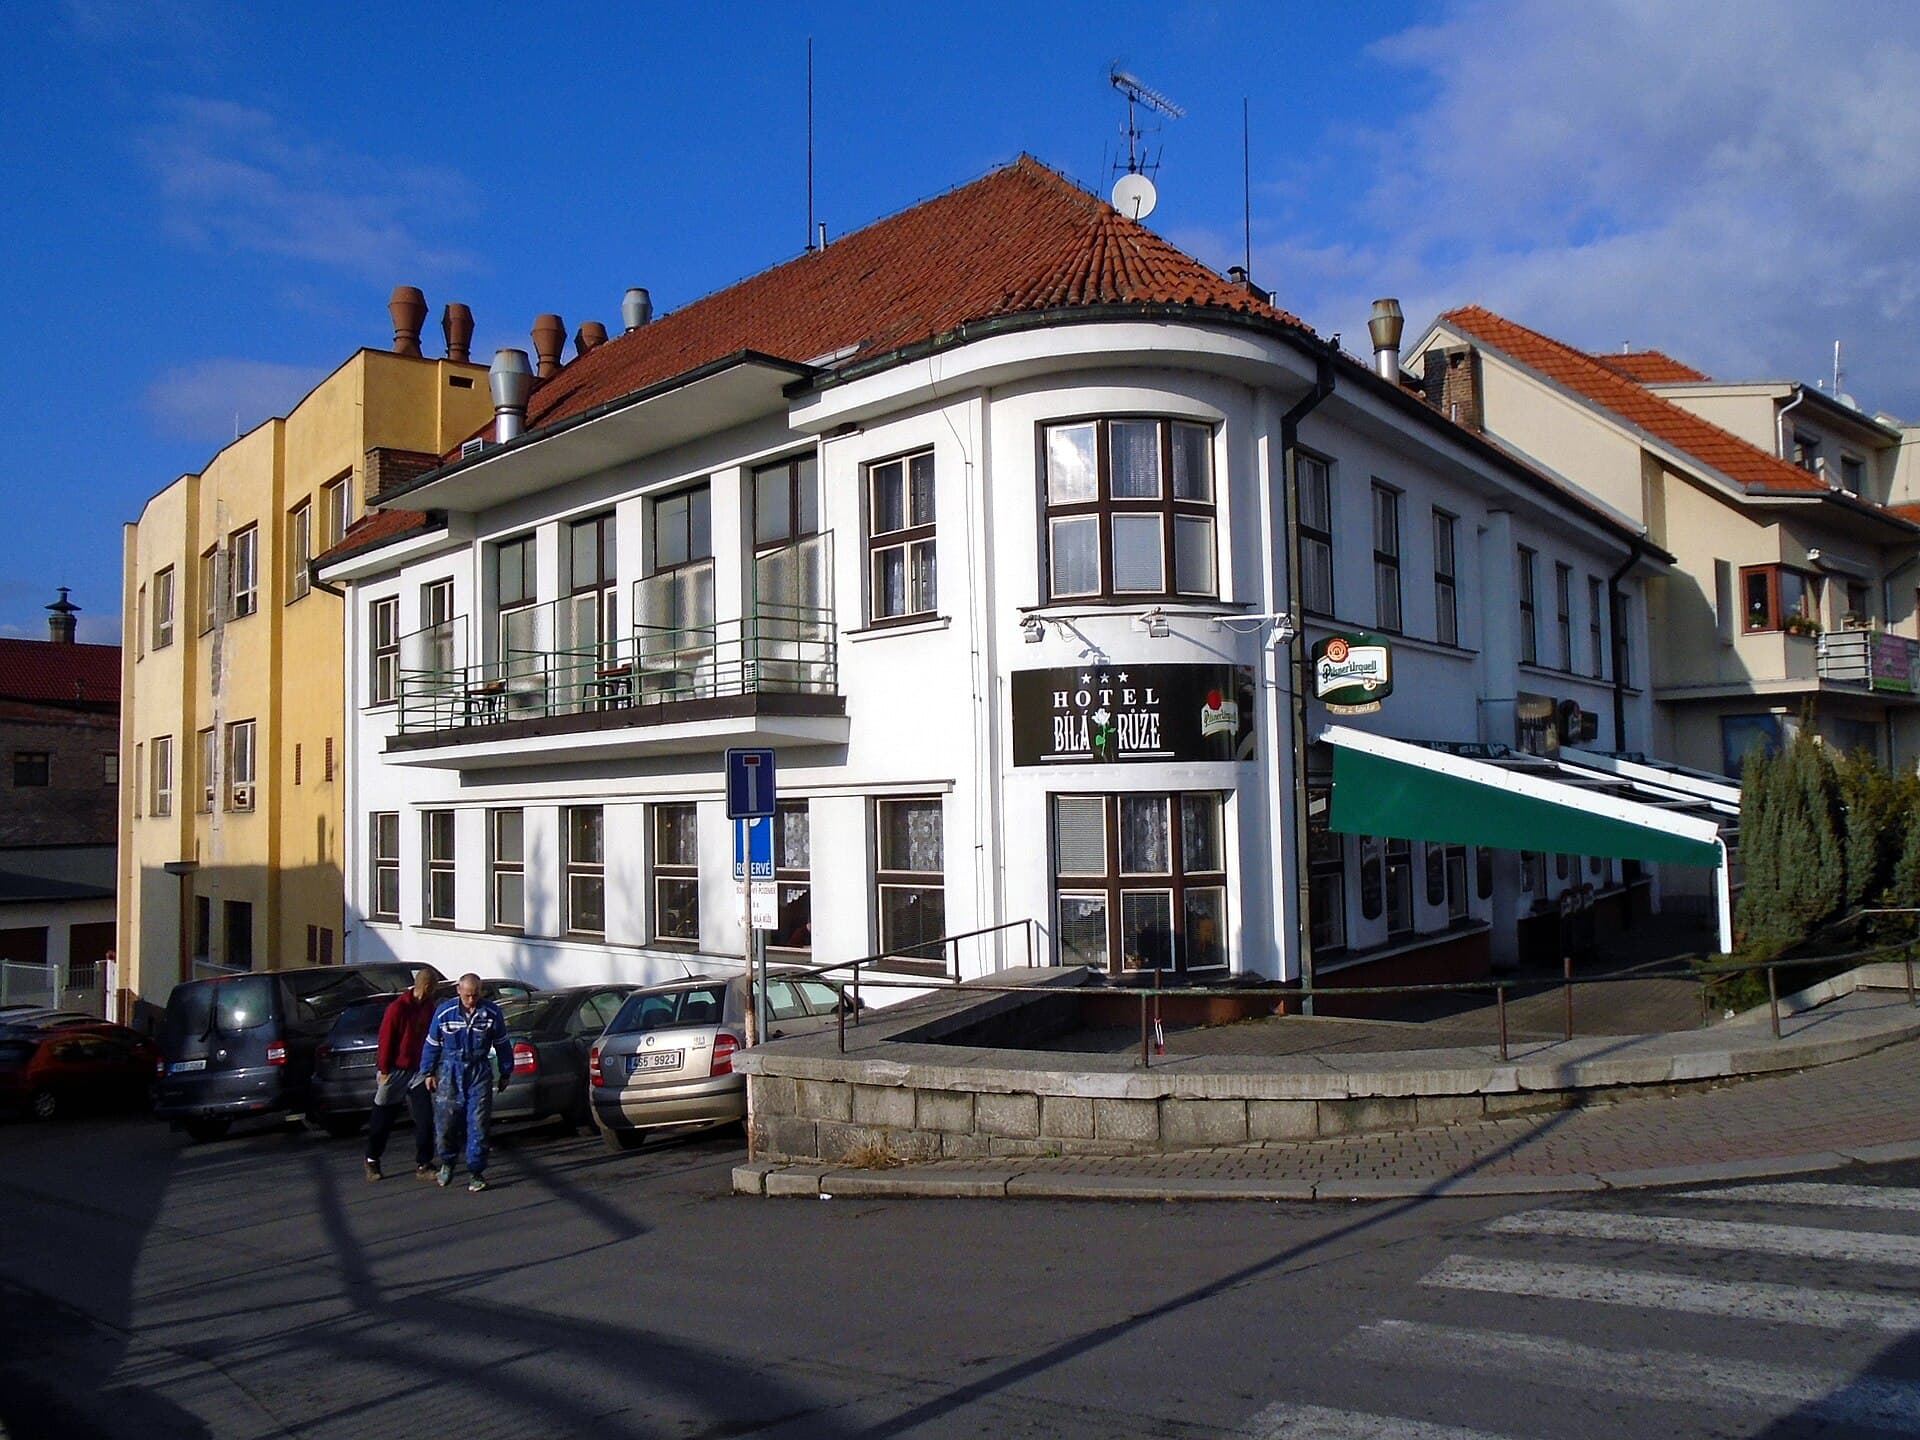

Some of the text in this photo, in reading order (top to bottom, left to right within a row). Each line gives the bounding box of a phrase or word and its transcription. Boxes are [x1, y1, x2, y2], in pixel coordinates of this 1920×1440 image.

[1322, 660, 1377, 684] Pilsner Urquell
[1053, 688, 1160, 708] HOTEL
[1053, 708, 1161, 752] BÍLÁ RŮŽE
[654, 1054, 675, 1065] 9923
